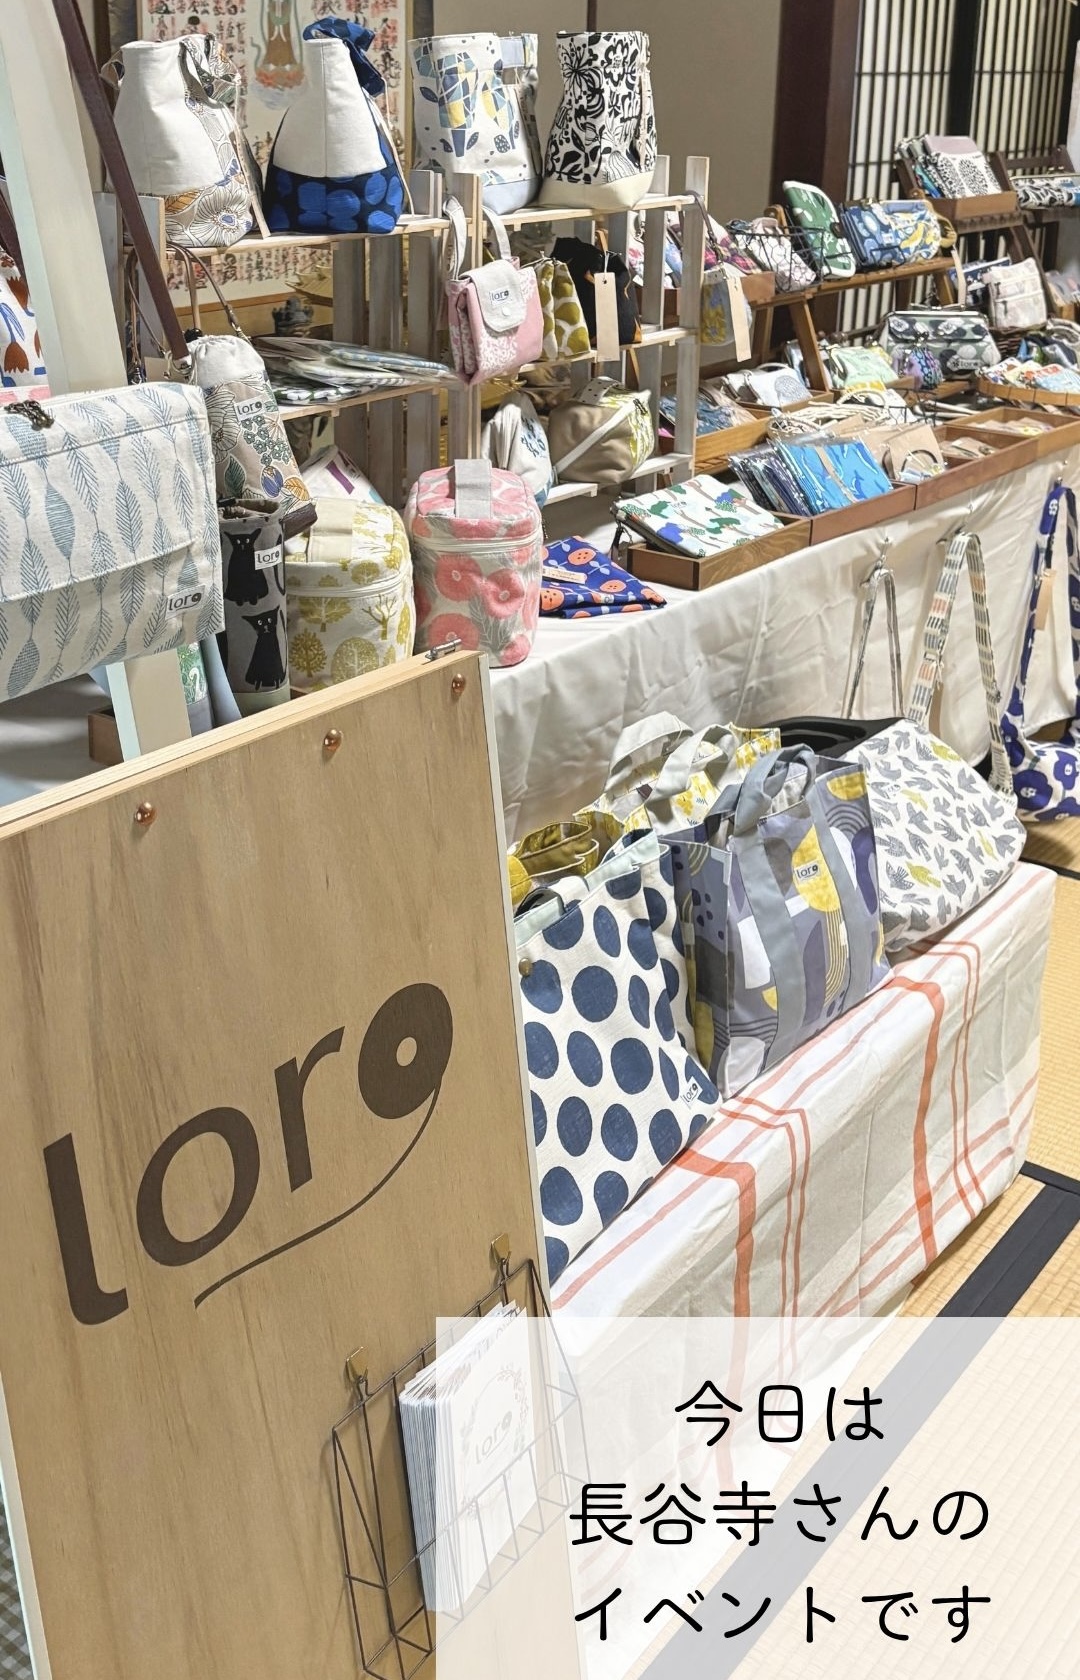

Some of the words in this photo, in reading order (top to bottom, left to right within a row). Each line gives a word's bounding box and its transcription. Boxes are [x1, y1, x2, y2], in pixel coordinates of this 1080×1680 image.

[491, 290, 509, 302] loro
[237, 401, 263, 415] loro
[257, 550, 280, 564] loro
[168, 592, 202, 612] loro
[796, 864, 819, 879] loro
[682, 1083, 699, 1103] loro
[43, 982, 454, 1326] loro
